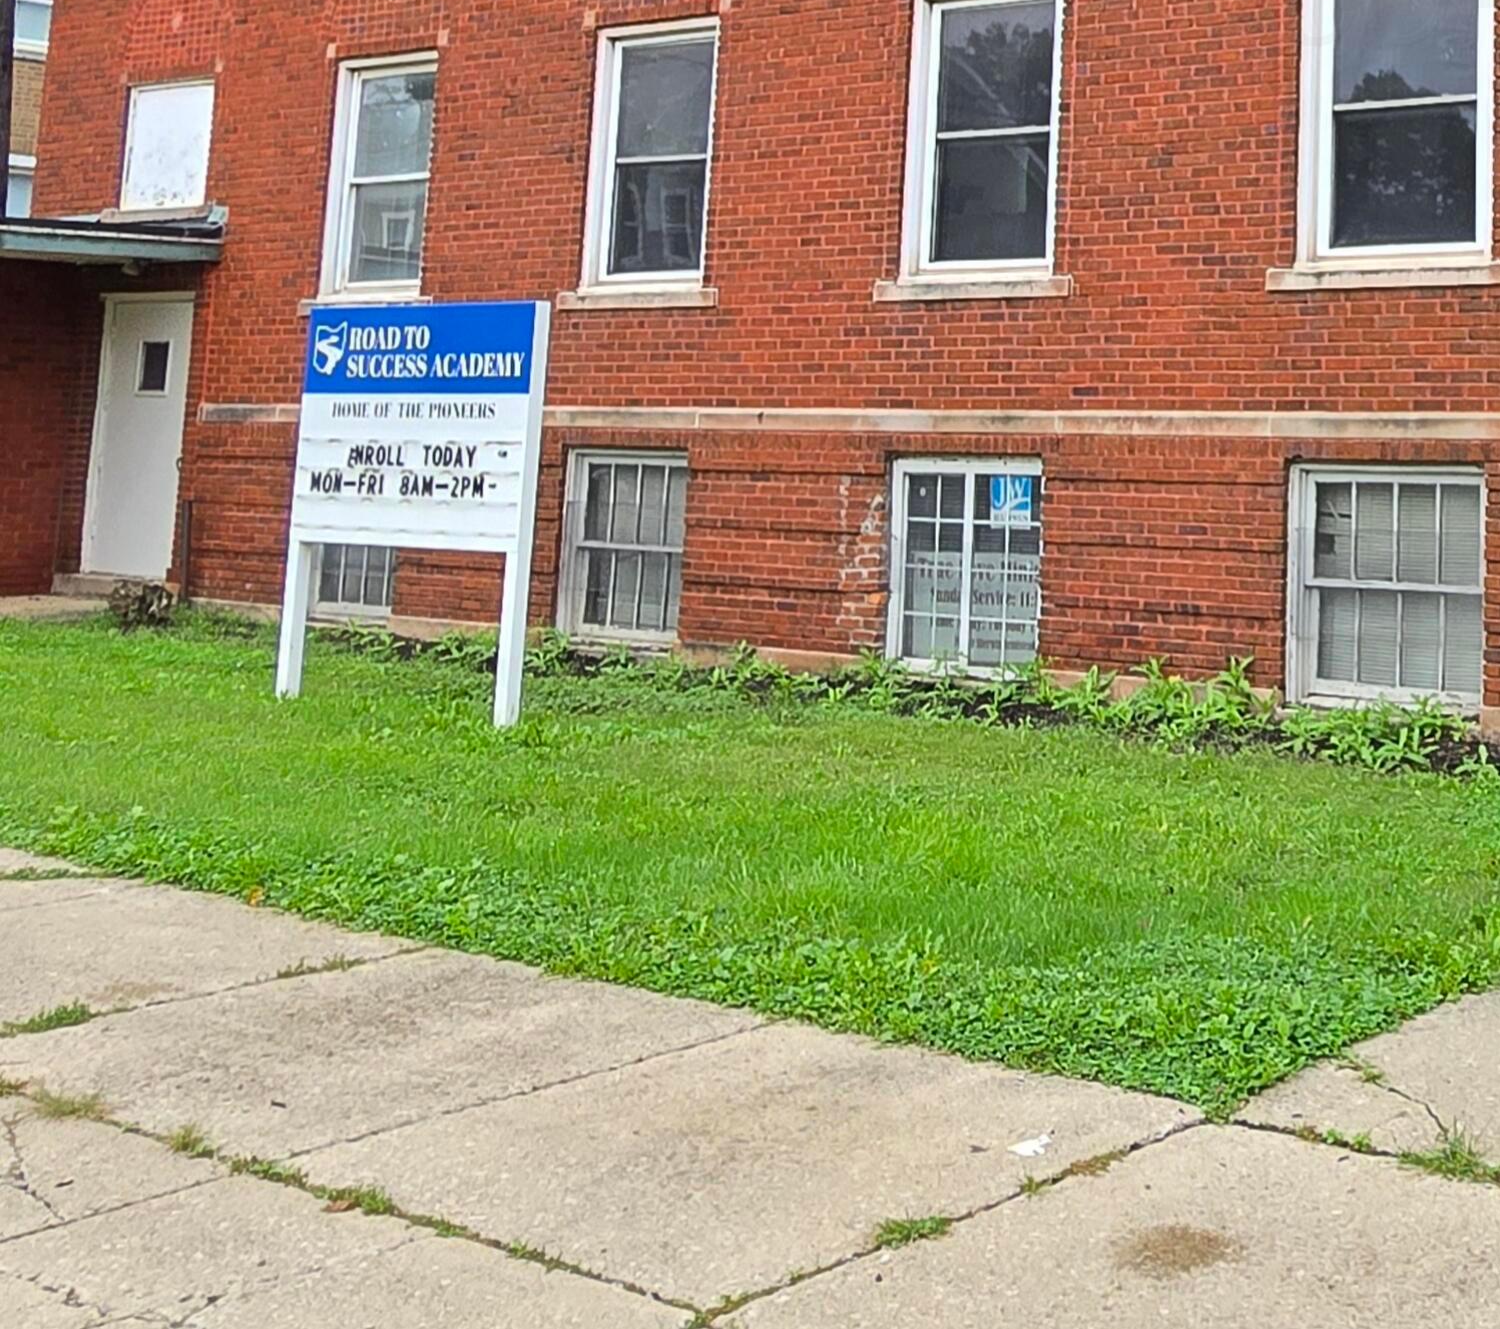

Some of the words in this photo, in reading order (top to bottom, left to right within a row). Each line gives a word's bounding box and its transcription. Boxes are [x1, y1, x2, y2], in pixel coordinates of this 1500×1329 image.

[349, 326, 401, 351] ROAD
[404, 325, 430, 350] TO
[346, 353, 428, 378] SUCCESS
[430, 352, 525, 378] ACADEMY
[331, 402, 370, 418] HOME
[374, 402, 392, 418] OF
[399, 402, 424, 418] THE
[428, 402, 496, 419] PIONEERS
[423, 445, 477, 468] TODAY
